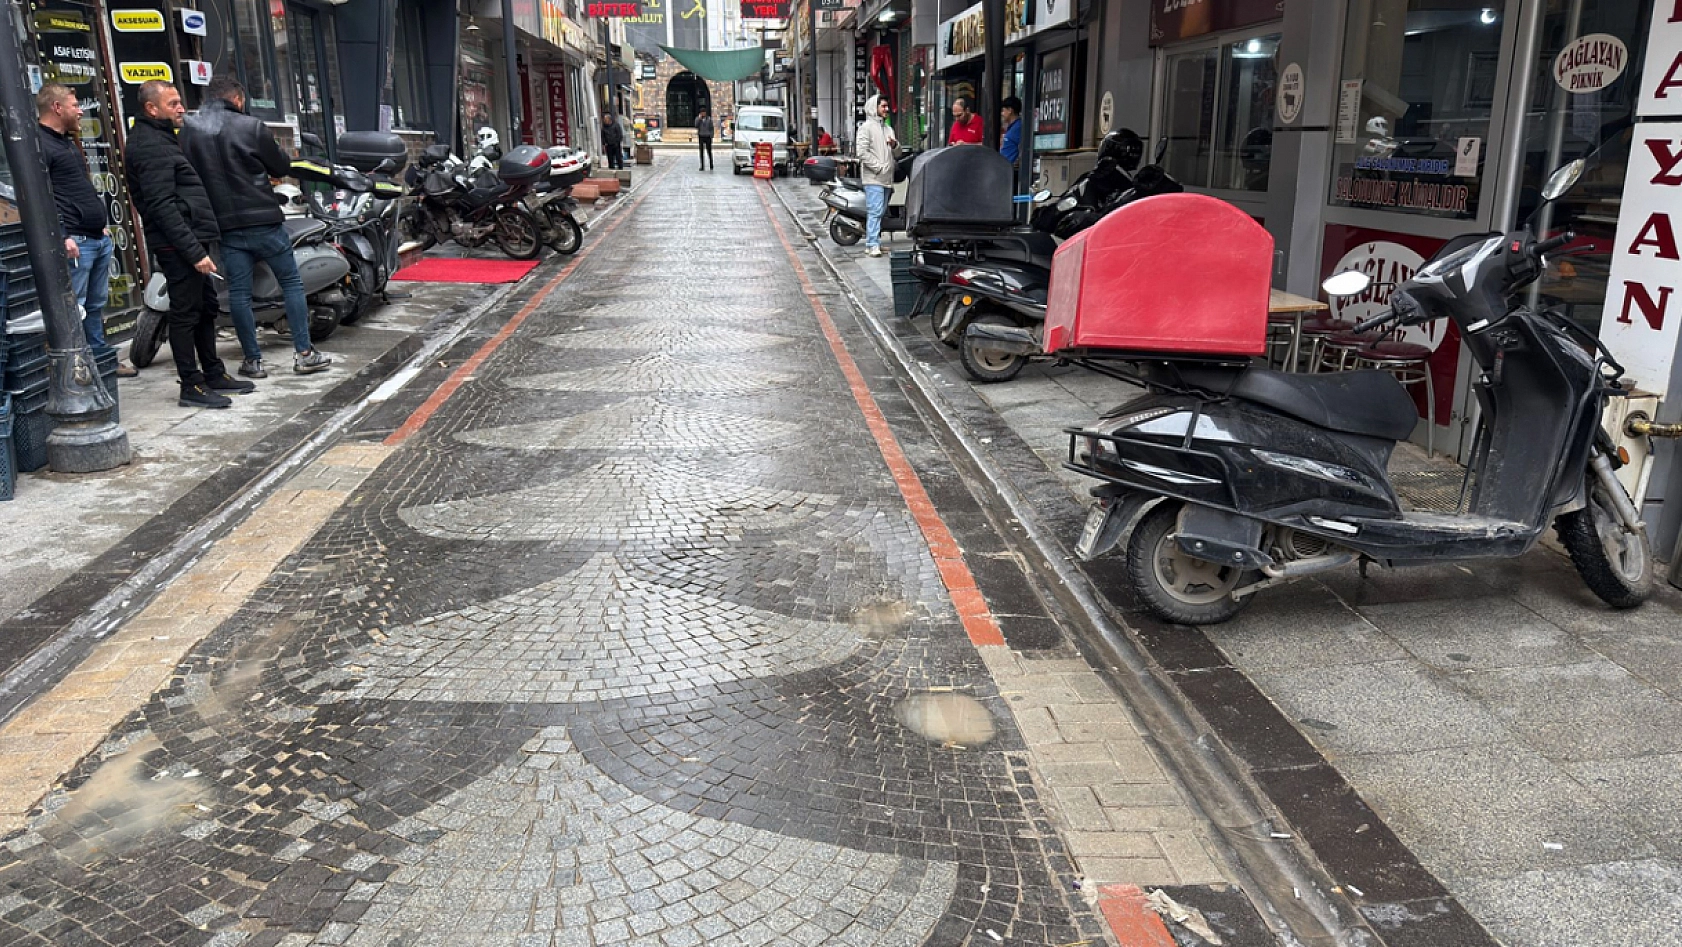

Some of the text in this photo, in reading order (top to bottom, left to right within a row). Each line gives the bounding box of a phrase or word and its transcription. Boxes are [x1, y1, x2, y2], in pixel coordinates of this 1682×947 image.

[587, 1, 638, 18] BİFTEK
[753, 3, 778, 16] YERİ
[117, 16, 159, 24] AKSESUAR
[1558, 37, 1623, 83] ÇAĞLAYAN
[125, 68, 166, 77] YAZILIM
[1569, 67, 1604, 90] PİKNİK
[1336, 176, 1469, 212] SALONUMUZ KLİMALIDIR
